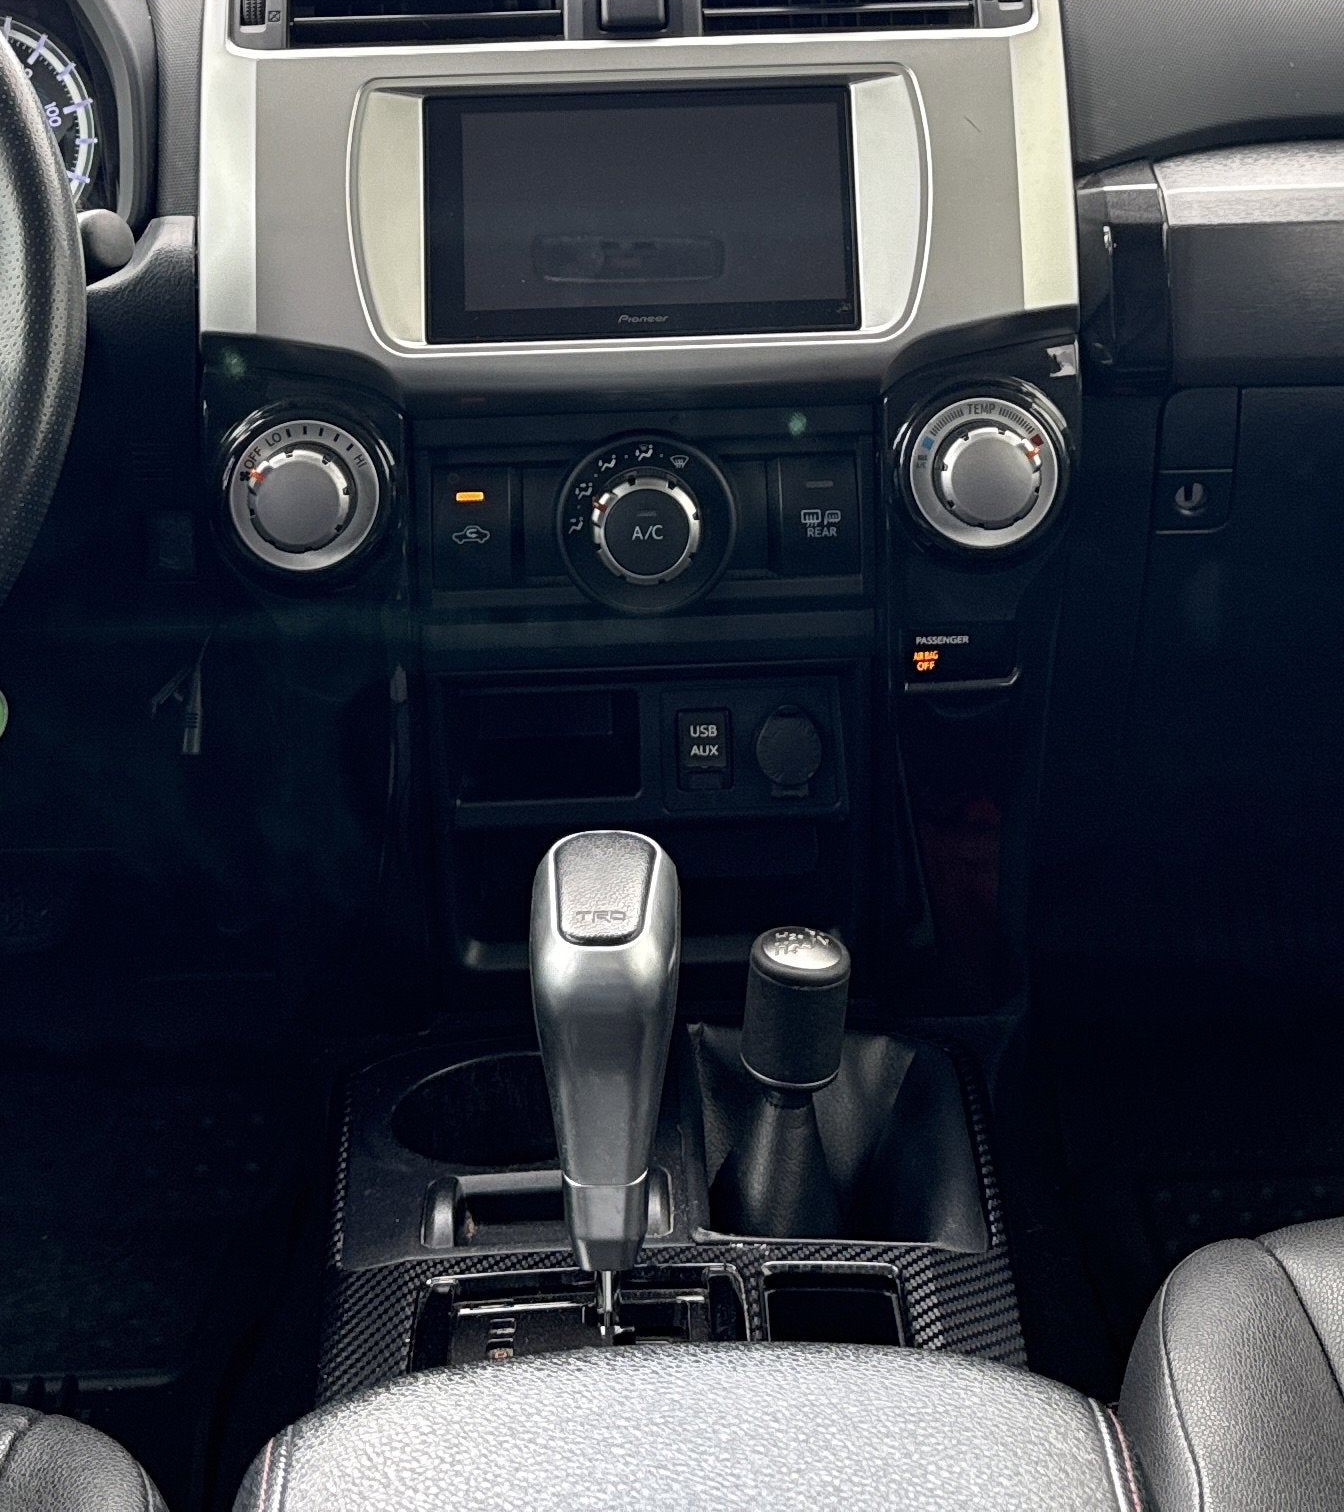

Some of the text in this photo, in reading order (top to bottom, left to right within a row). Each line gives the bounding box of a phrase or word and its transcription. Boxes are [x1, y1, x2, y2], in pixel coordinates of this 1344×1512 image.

[43, 101, 62, 128] 100
[618, 314, 669, 324] Pioneer
[967, 403, 997, 415] TEMP
[265, 433, 282, 447] LO
[244, 446, 262, 469] OFF
[353, 453, 367, 468] HI
[631, 524, 664, 540] A/C
[807, 527, 838, 538] REAR
[916, 635, 969, 645] PASSENGER
[916, 661, 935, 671] OFF
[690, 724, 717, 737] USB
[690, 744, 719, 756] AUX
[575, 910, 628, 924] TRD
